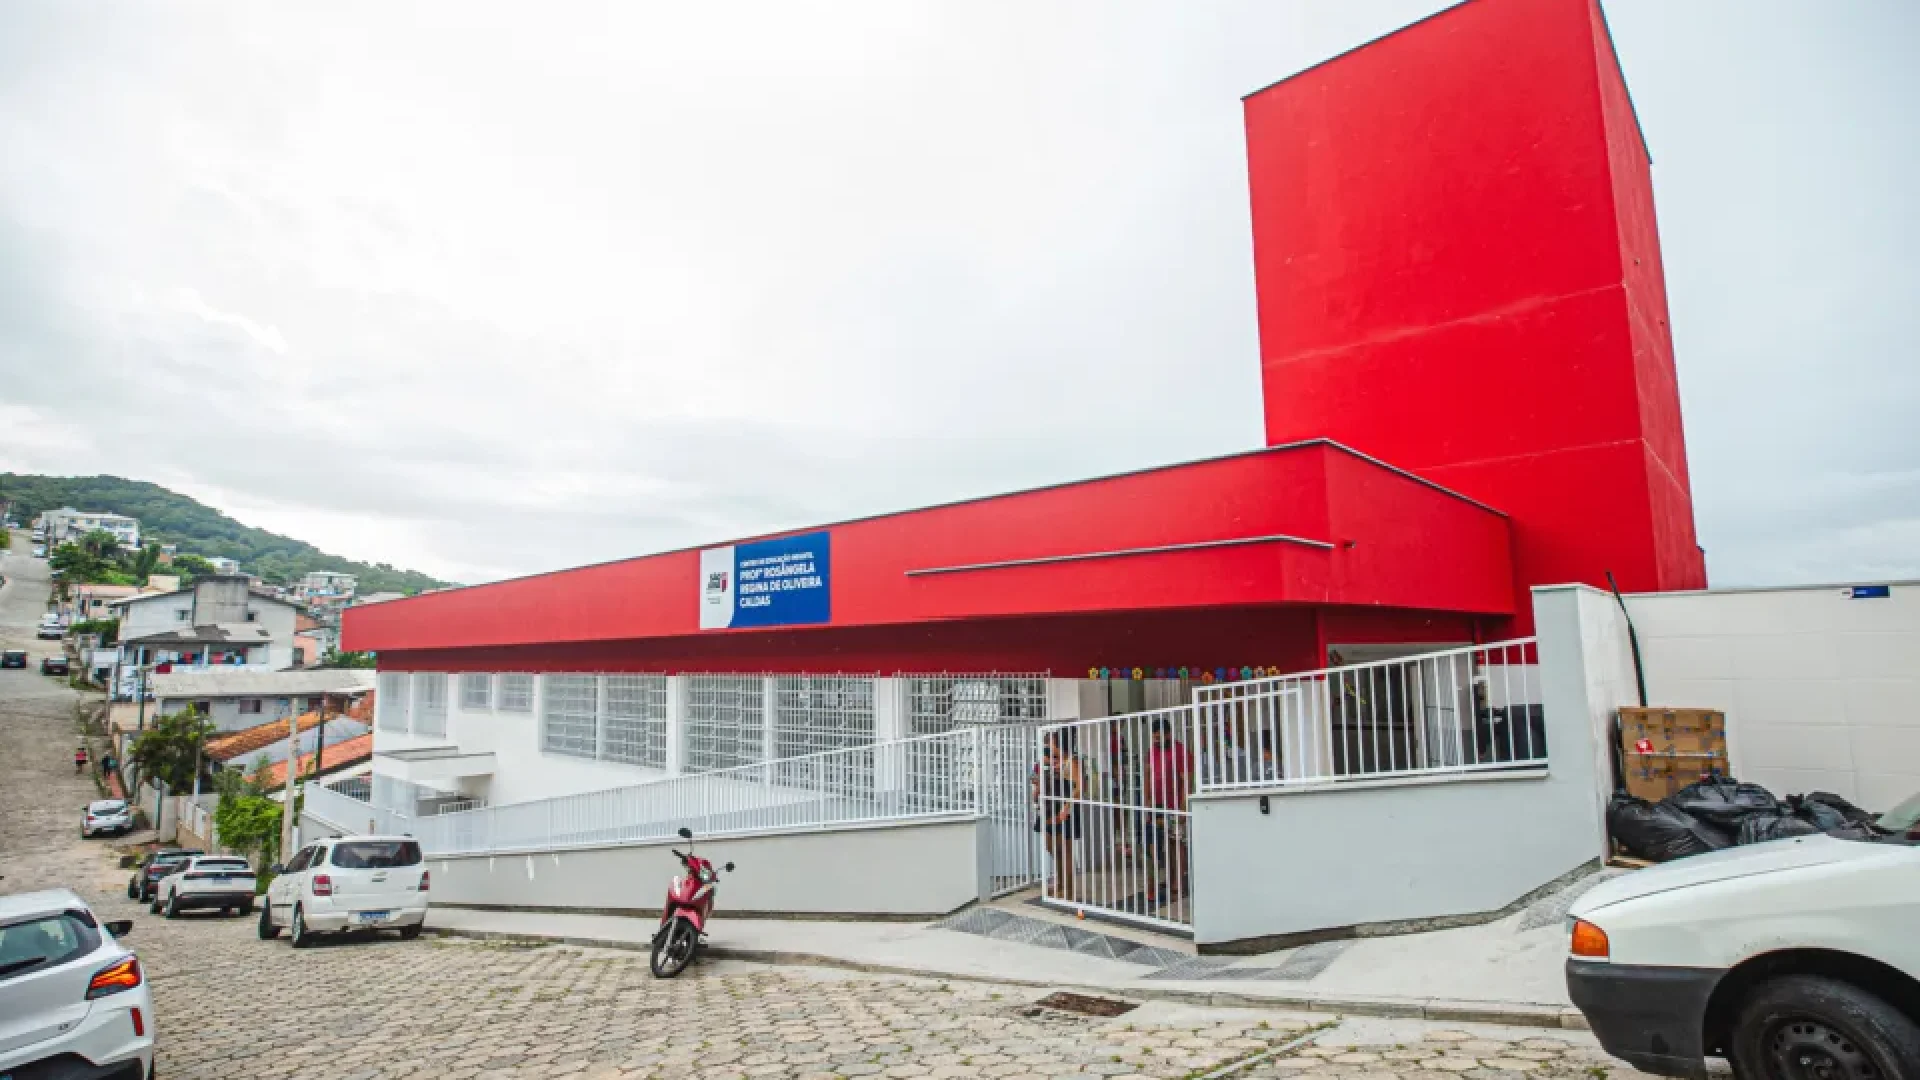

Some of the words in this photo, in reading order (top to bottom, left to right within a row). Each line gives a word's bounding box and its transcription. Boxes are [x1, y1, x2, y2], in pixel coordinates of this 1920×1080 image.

[764, 561, 815, 577] ROSÂNGELA
[740, 582, 768, 594] REGINA
[769, 579, 781, 591] DE
[782, 576, 822, 589] OLIVEIRA
[740, 595, 770, 608] CALDAS
